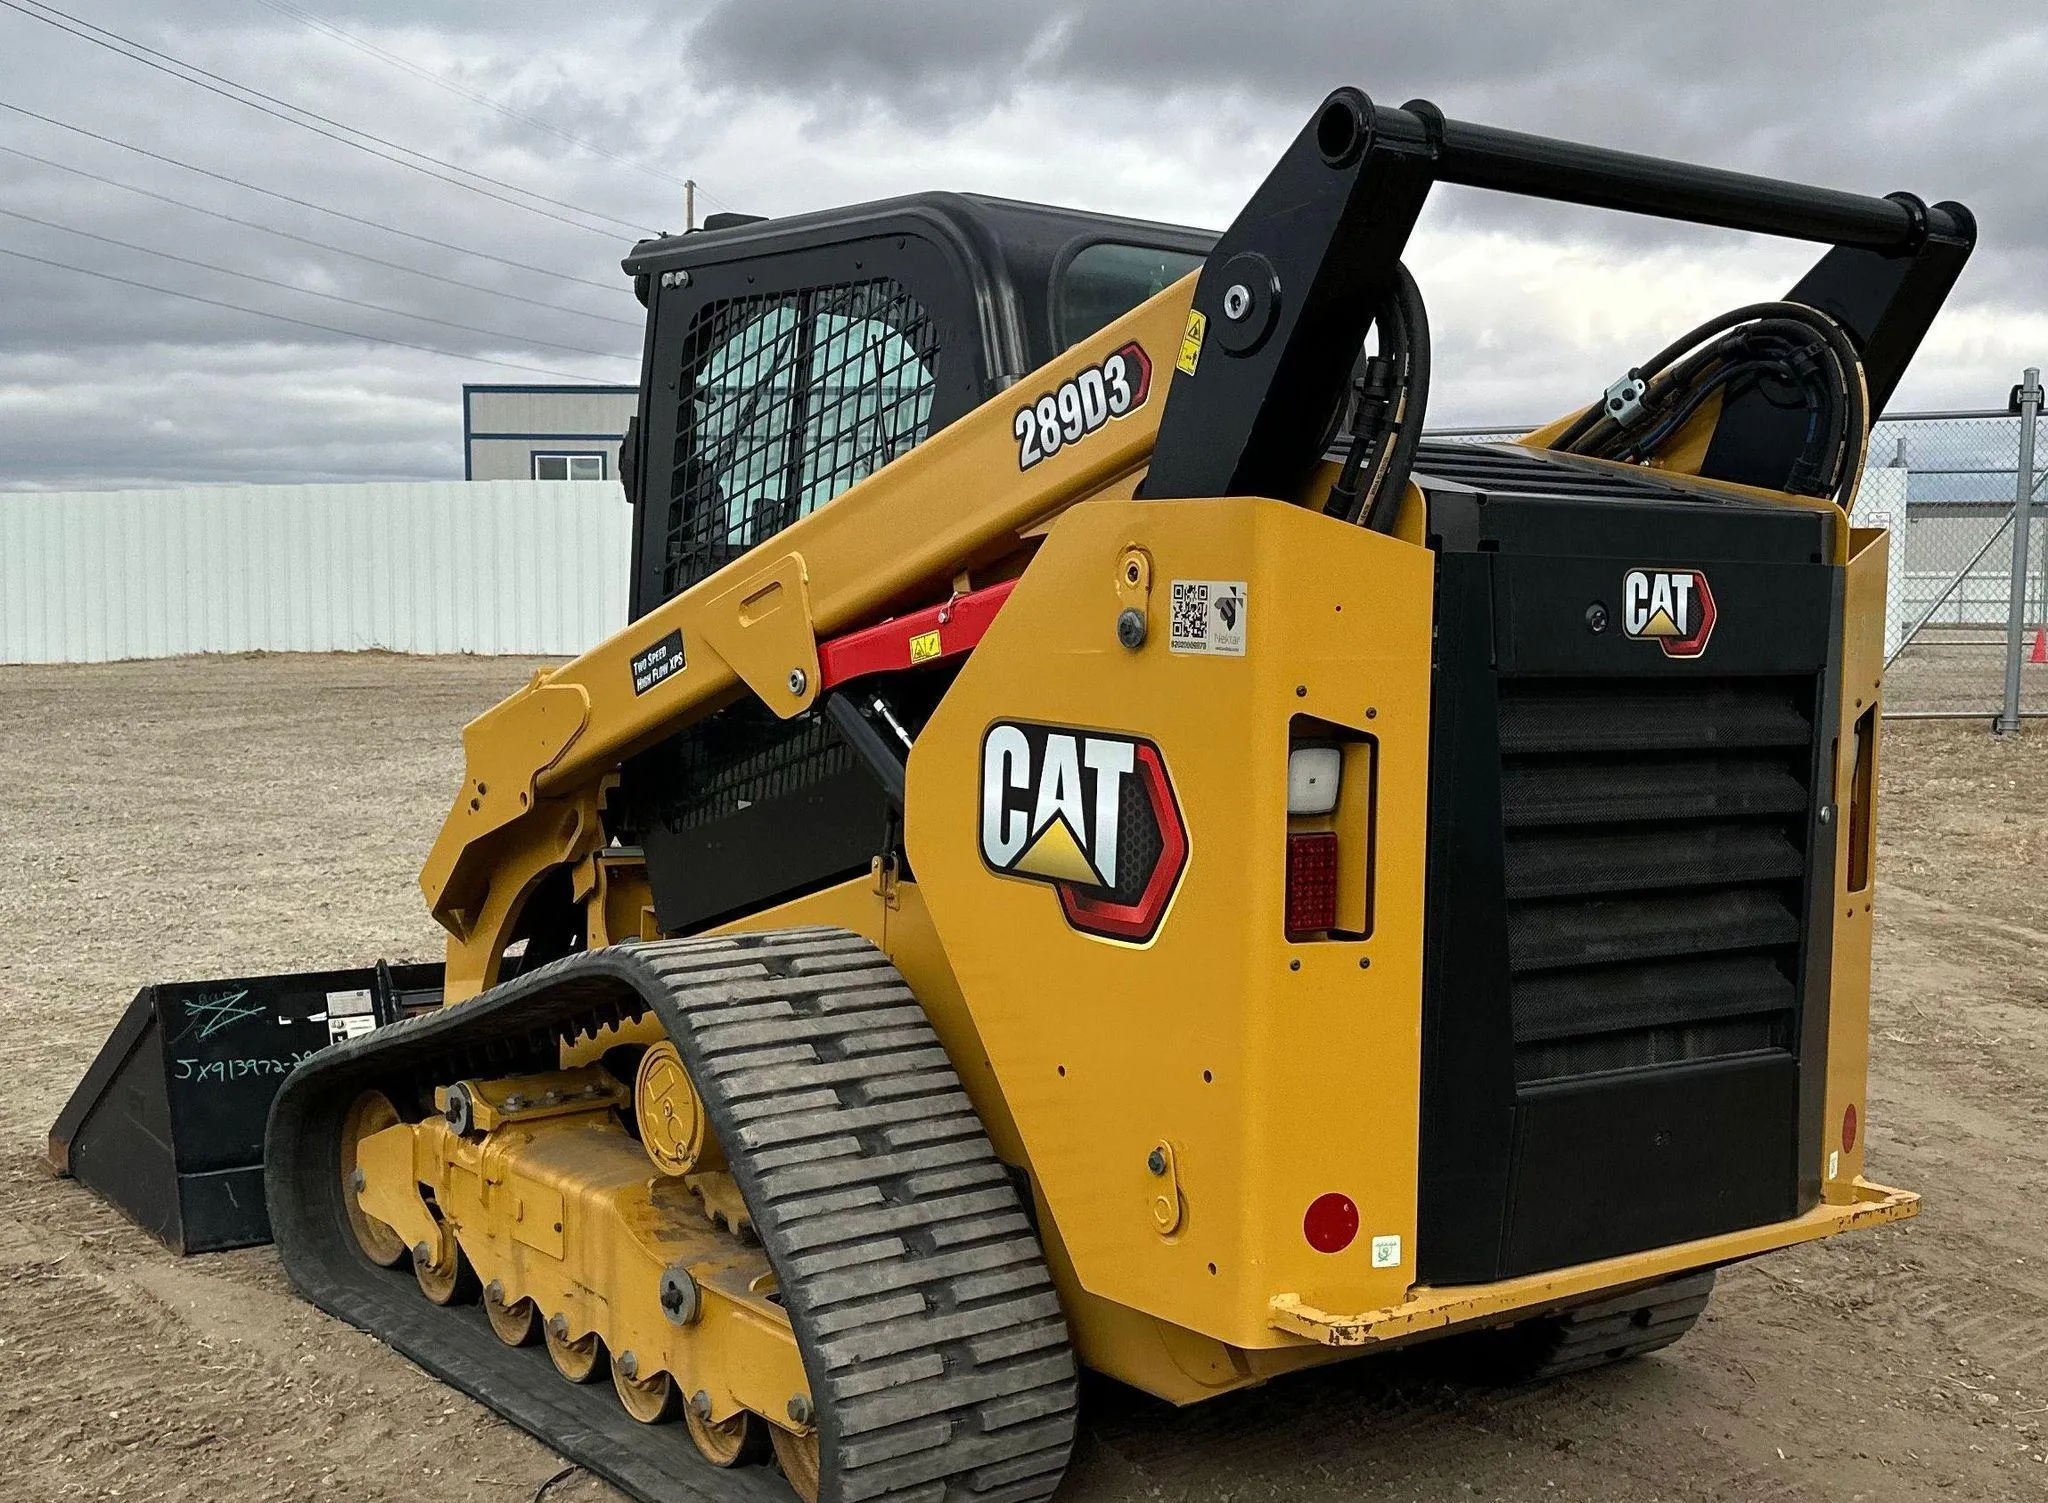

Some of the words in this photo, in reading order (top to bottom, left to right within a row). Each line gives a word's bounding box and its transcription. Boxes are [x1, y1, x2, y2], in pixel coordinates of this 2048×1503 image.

[1015, 355, 1131, 467] 289D3
[1625, 571, 1693, 635] CAT
[669, 651, 683, 671] XPS
[983, 725, 1135, 889] CAT
